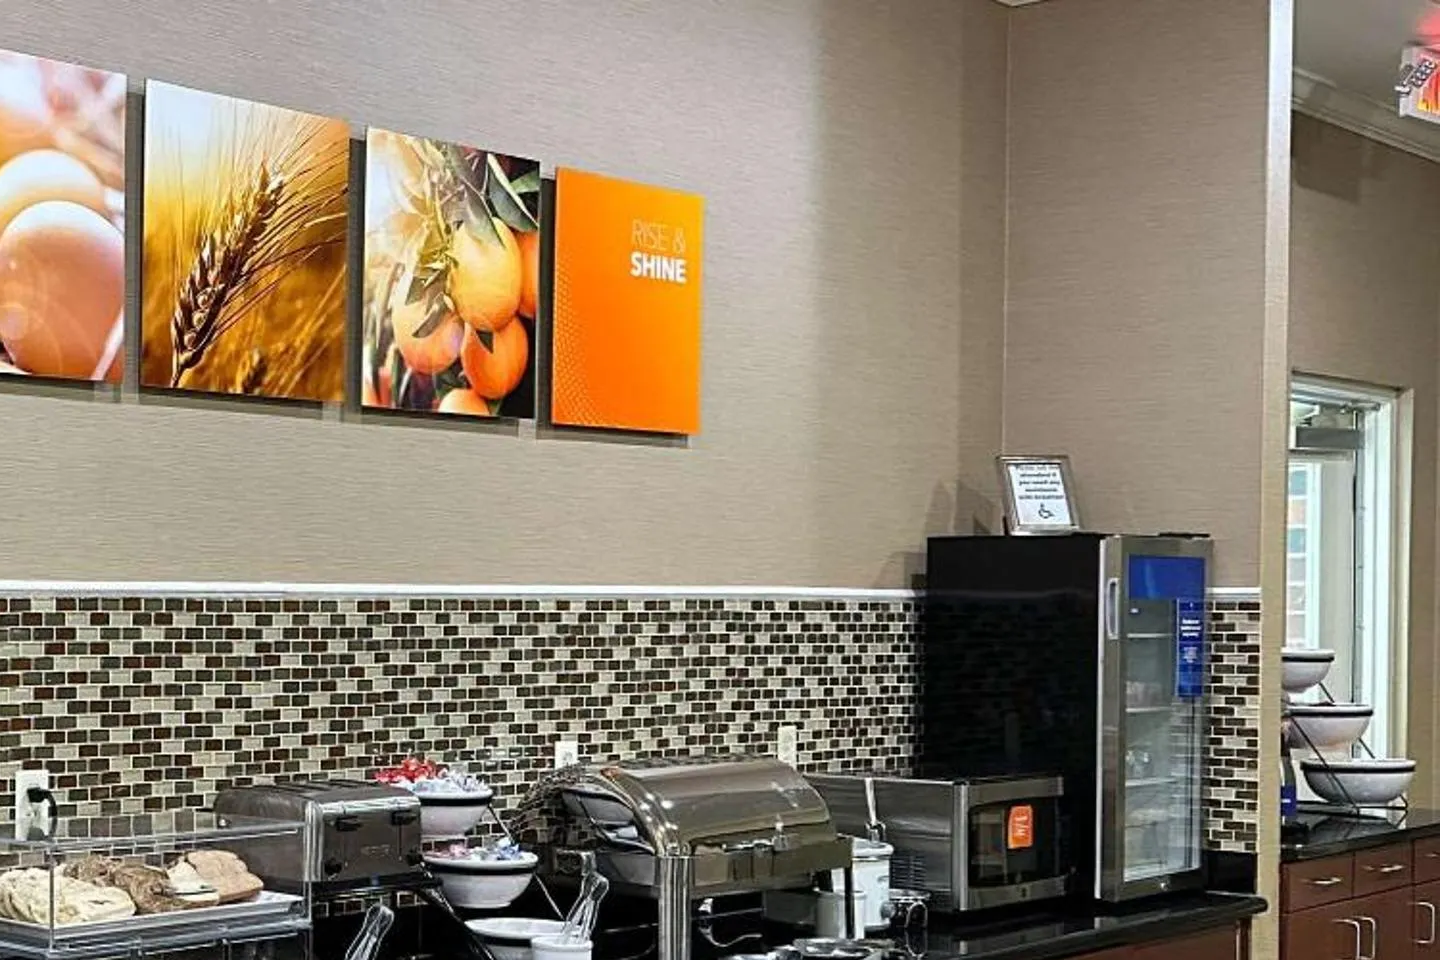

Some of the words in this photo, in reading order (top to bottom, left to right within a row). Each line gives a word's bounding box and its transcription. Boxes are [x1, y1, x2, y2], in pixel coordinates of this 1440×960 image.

[631, 218, 668, 251] RISE
[671, 227, 686, 254] &
[630, 250, 687, 284] SHINE
